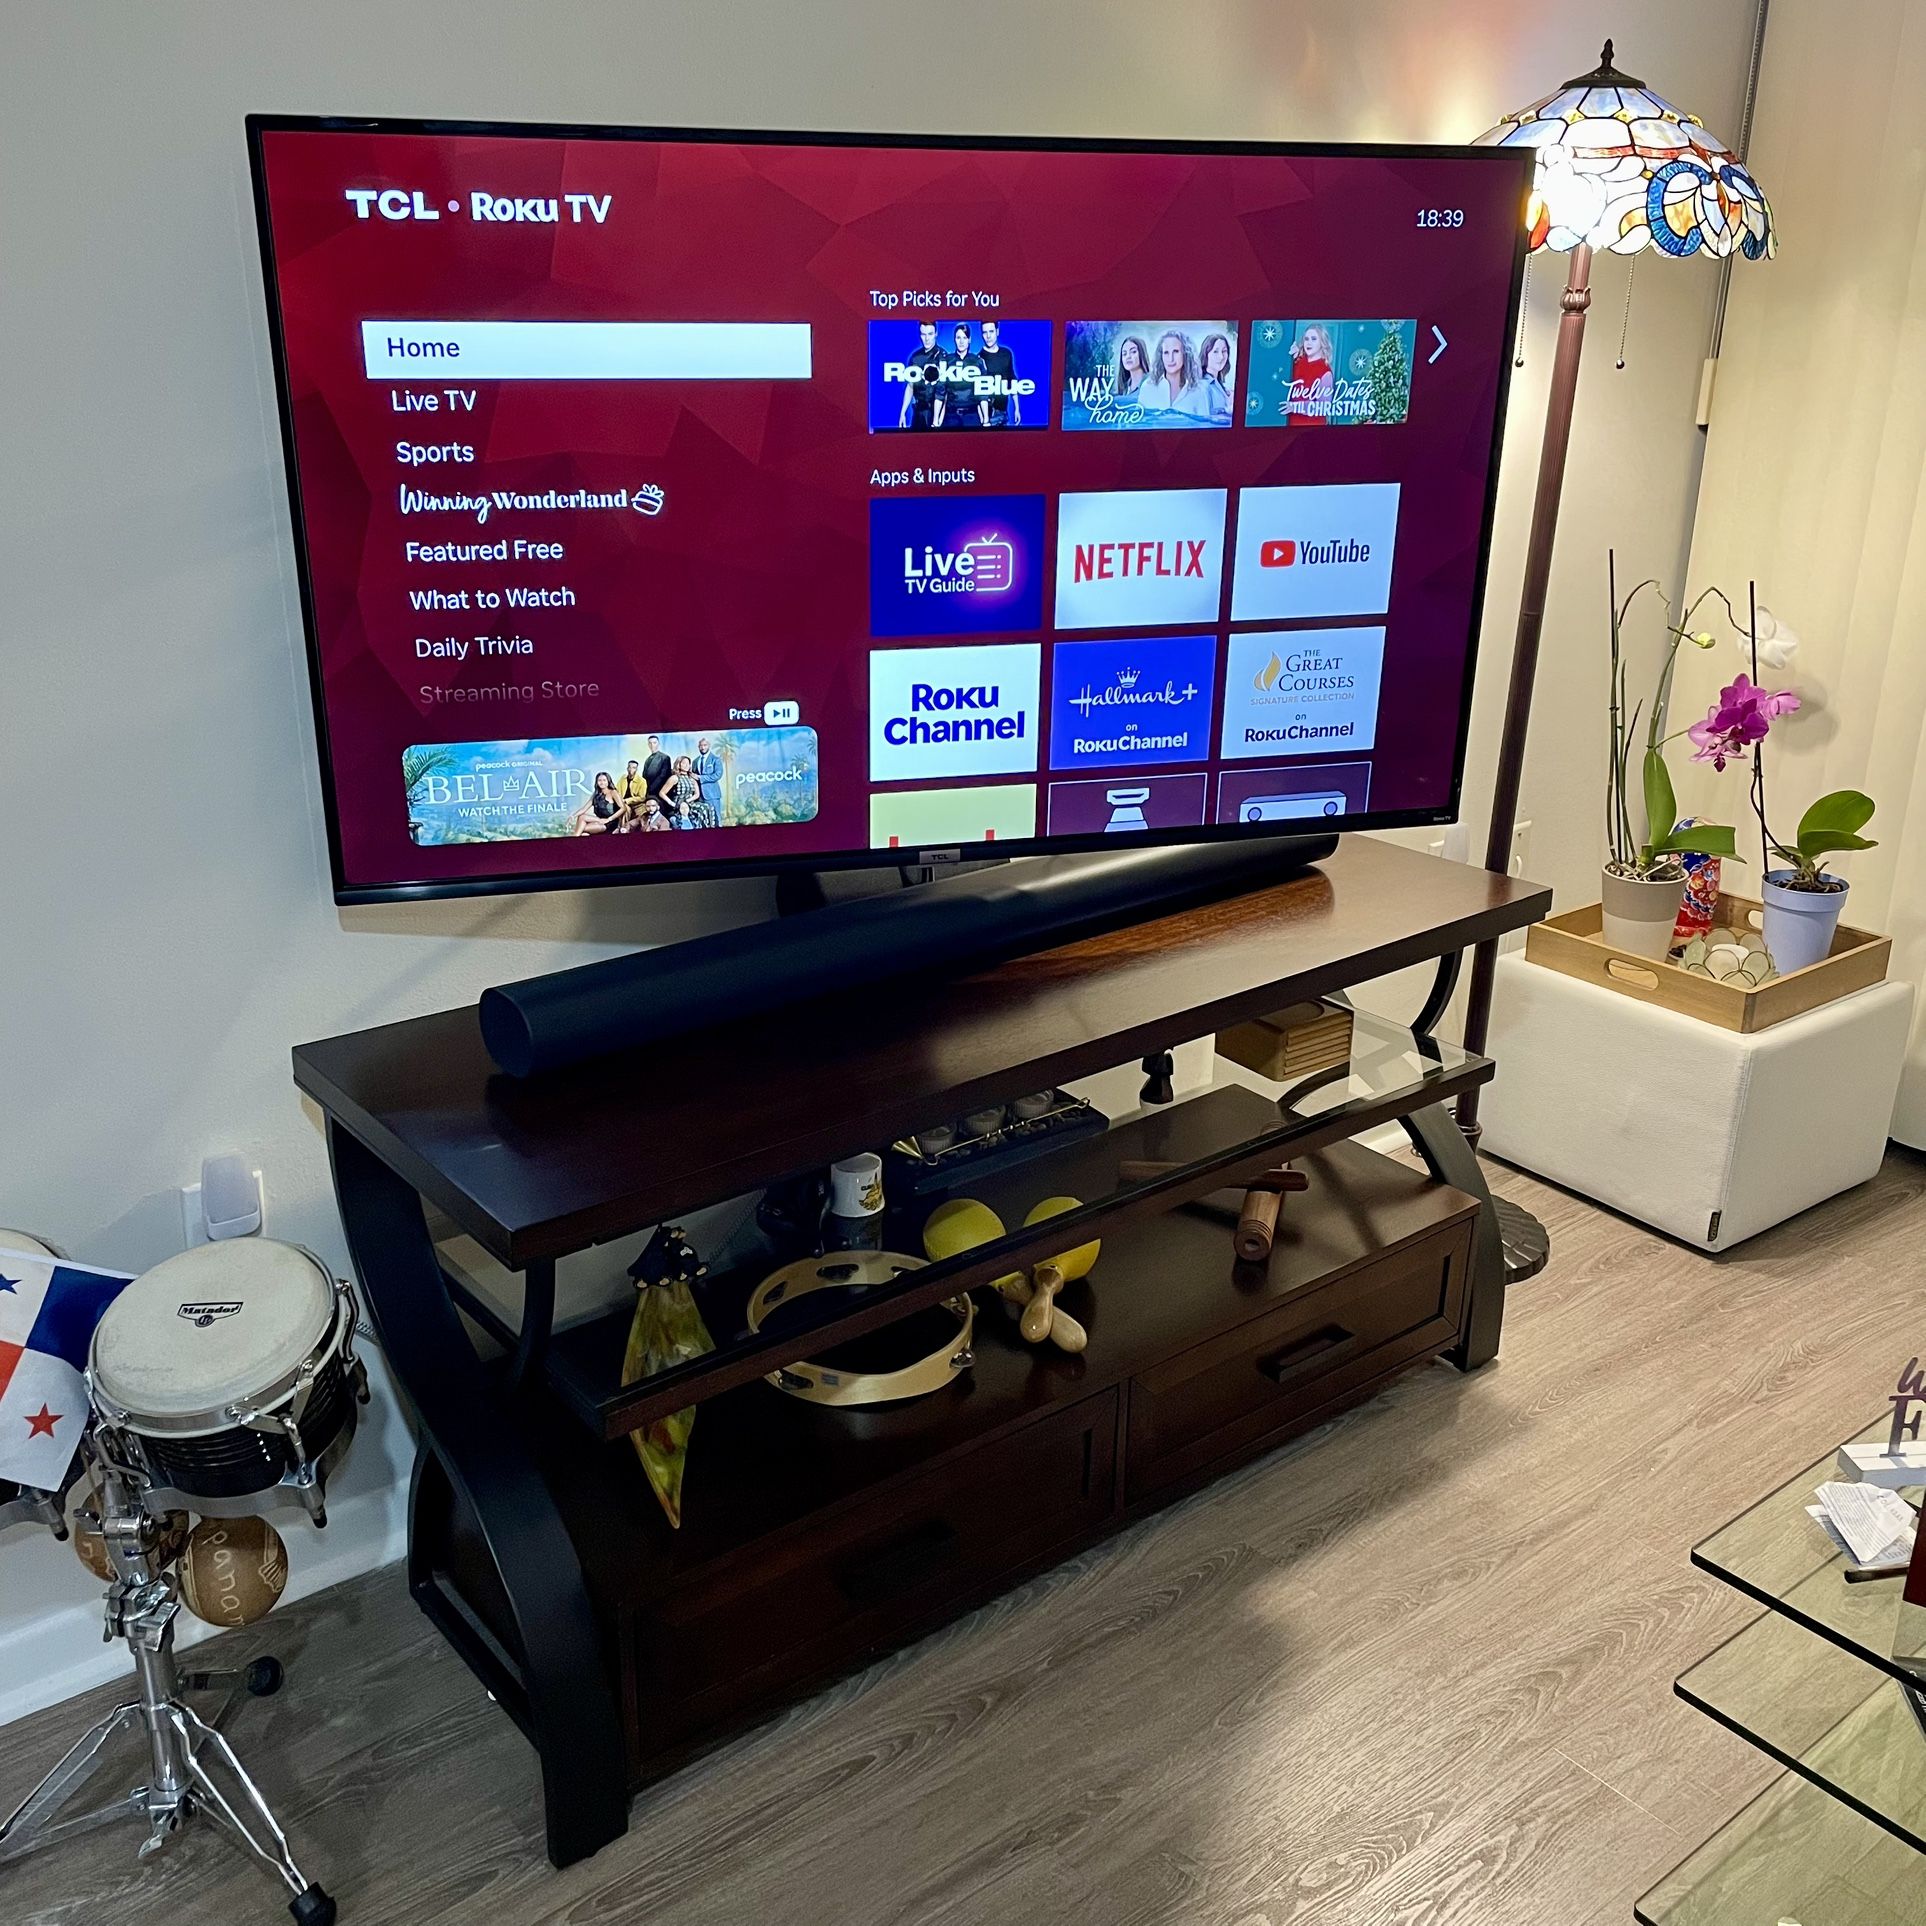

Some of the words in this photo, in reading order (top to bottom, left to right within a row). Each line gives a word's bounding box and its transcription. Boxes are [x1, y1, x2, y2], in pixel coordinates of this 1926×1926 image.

[345, 189, 440, 220] TCL
[470, 191, 559, 222] Roku
[564, 194, 612, 223] TV
[1416, 209, 1464, 227] 18:39
[869, 290, 898, 310] Top
[903, 290, 941, 307] Picks
[946, 290, 968, 307] for
[971, 291, 1000, 307] You
[387, 337, 461, 358] Home
[1095, 364, 1115, 377] THE
[973, 374, 1035, 396] Blue
[1069, 377, 1115, 402] WAY
[1281, 377, 1334, 402] Twelve
[1332, 376, 1375, 404] Dates
[391, 389, 439, 411] Live
[443, 389, 477, 411] TV
[1084, 394, 1144, 424] home
[1307, 399, 1376, 417] CHRISTMAS
[396, 441, 475, 467] Sports
[869, 469, 909, 487] Apps
[913, 467, 924, 484] &
[928, 468, 976, 486] Inputs
[399, 483, 492, 524] Winning
[491, 489, 628, 509] Wonderland
[405, 539, 508, 562] Featured
[513, 539, 564, 560] Free
[904, 545, 975, 578] Live
[1074, 540, 1206, 583] NETFLIX
[1300, 538, 1370, 565] YouTube
[904, 578, 927, 594] TV
[929, 577, 975, 593] Guide
[409, 589, 470, 610] What
[475, 590, 500, 609] to
[505, 586, 576, 608] Watch
[415, 637, 469, 661] Daily
[474, 635, 534, 656] Trivia
[1304, 649, 1321, 657] THE
[1286, 654, 1343, 673] GREAT
[419, 682, 534, 704] Streaming
[541, 680, 600, 698] Store
[1278, 674, 1355, 692] COURSES
[911, 683, 1000, 712] Roku
[1250, 696, 1299, 706] SIGNATURE
[1301, 692, 1355, 703] COLLECTION
[729, 708, 762, 720] Press
[884, 711, 1025, 745] Channel
[1125, 722, 1138, 732] on
[475, 760, 511, 772] peacock
[424, 773, 504, 805] BEL
[521, 768, 595, 799] AIR
[735, 766, 803, 790] peacock
[458, 806, 503, 818] WATCH
[503, 804, 525, 815] THE
[527, 802, 568, 813] FINALE
[181, 1305, 239, 1314] Matador
